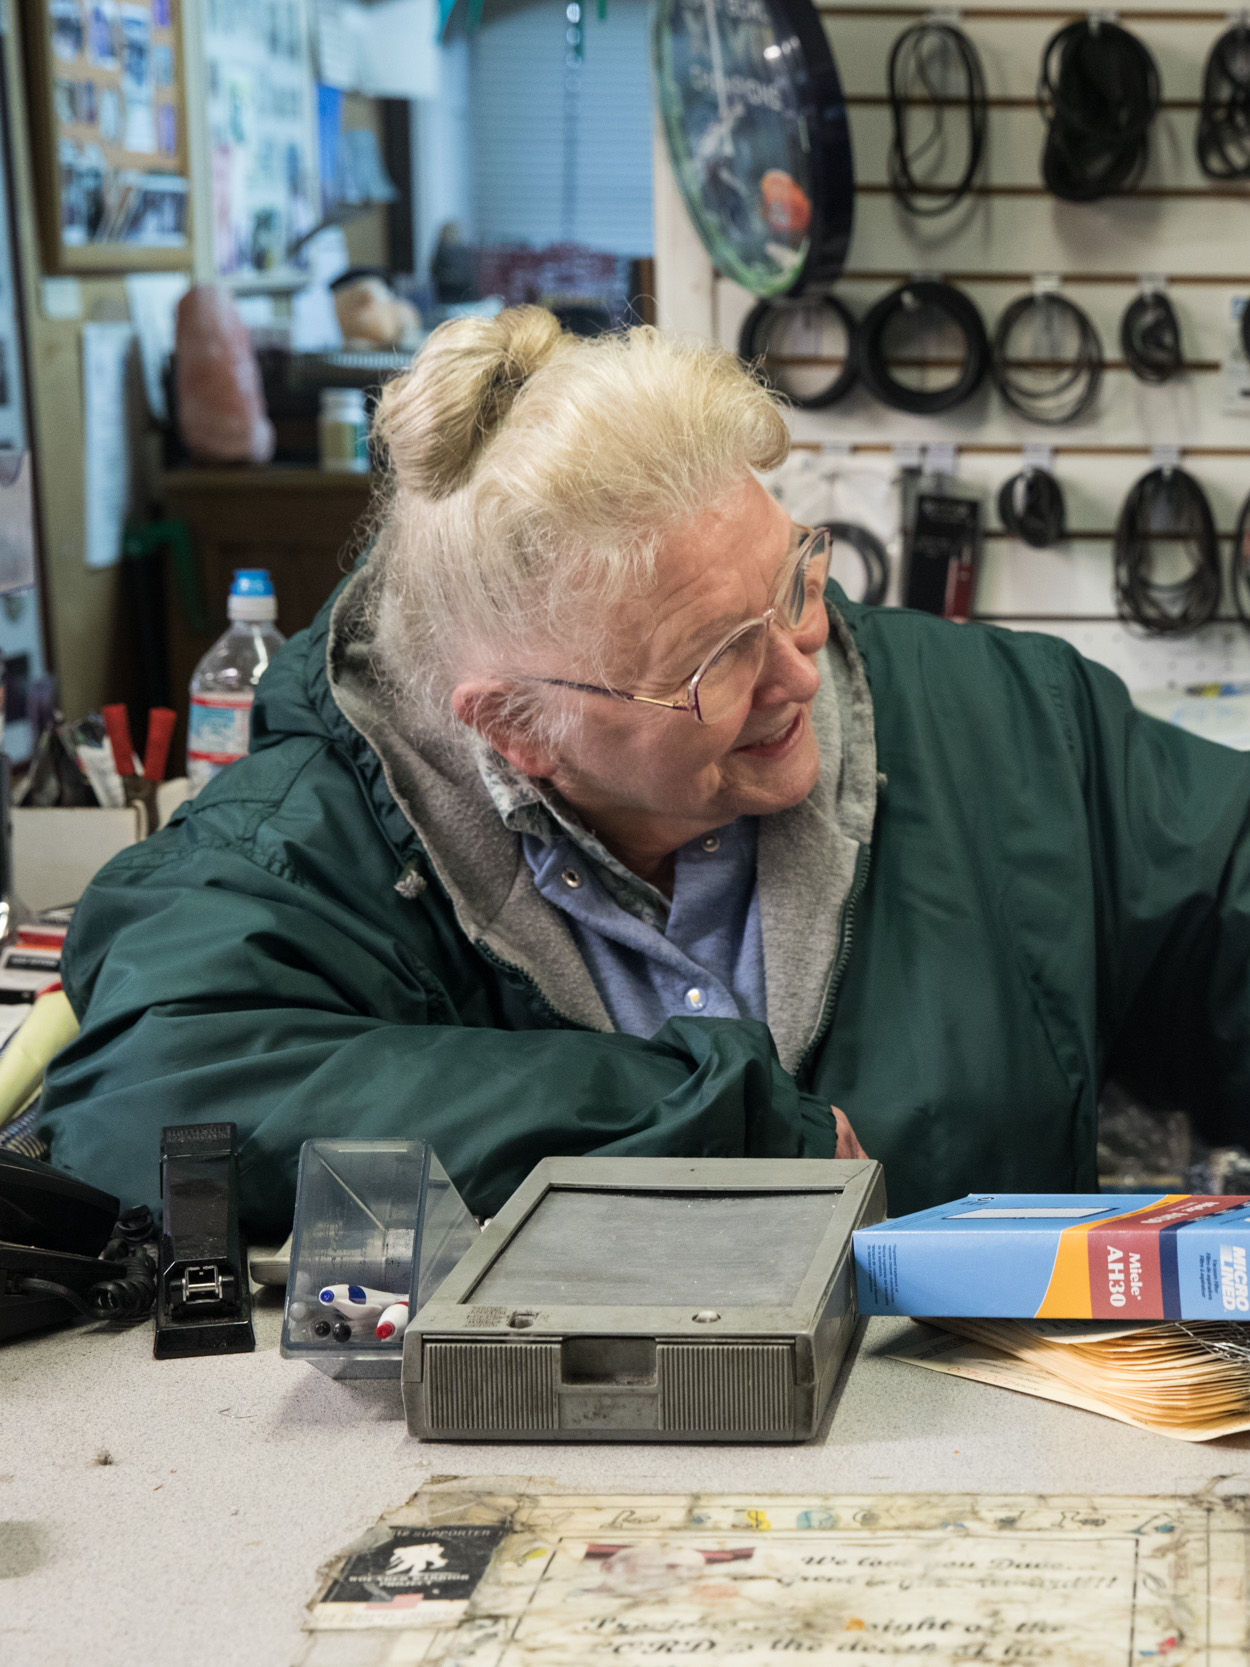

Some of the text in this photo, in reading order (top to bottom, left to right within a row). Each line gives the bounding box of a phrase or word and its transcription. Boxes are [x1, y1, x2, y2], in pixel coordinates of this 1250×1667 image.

[1106, 1245, 1127, 1308] AH30
[1220, 1247, 1236, 1312] LINED
[1232, 1246, 1249, 1312] MICRO
[411, 1528, 491, 1540] SUPPORTER
